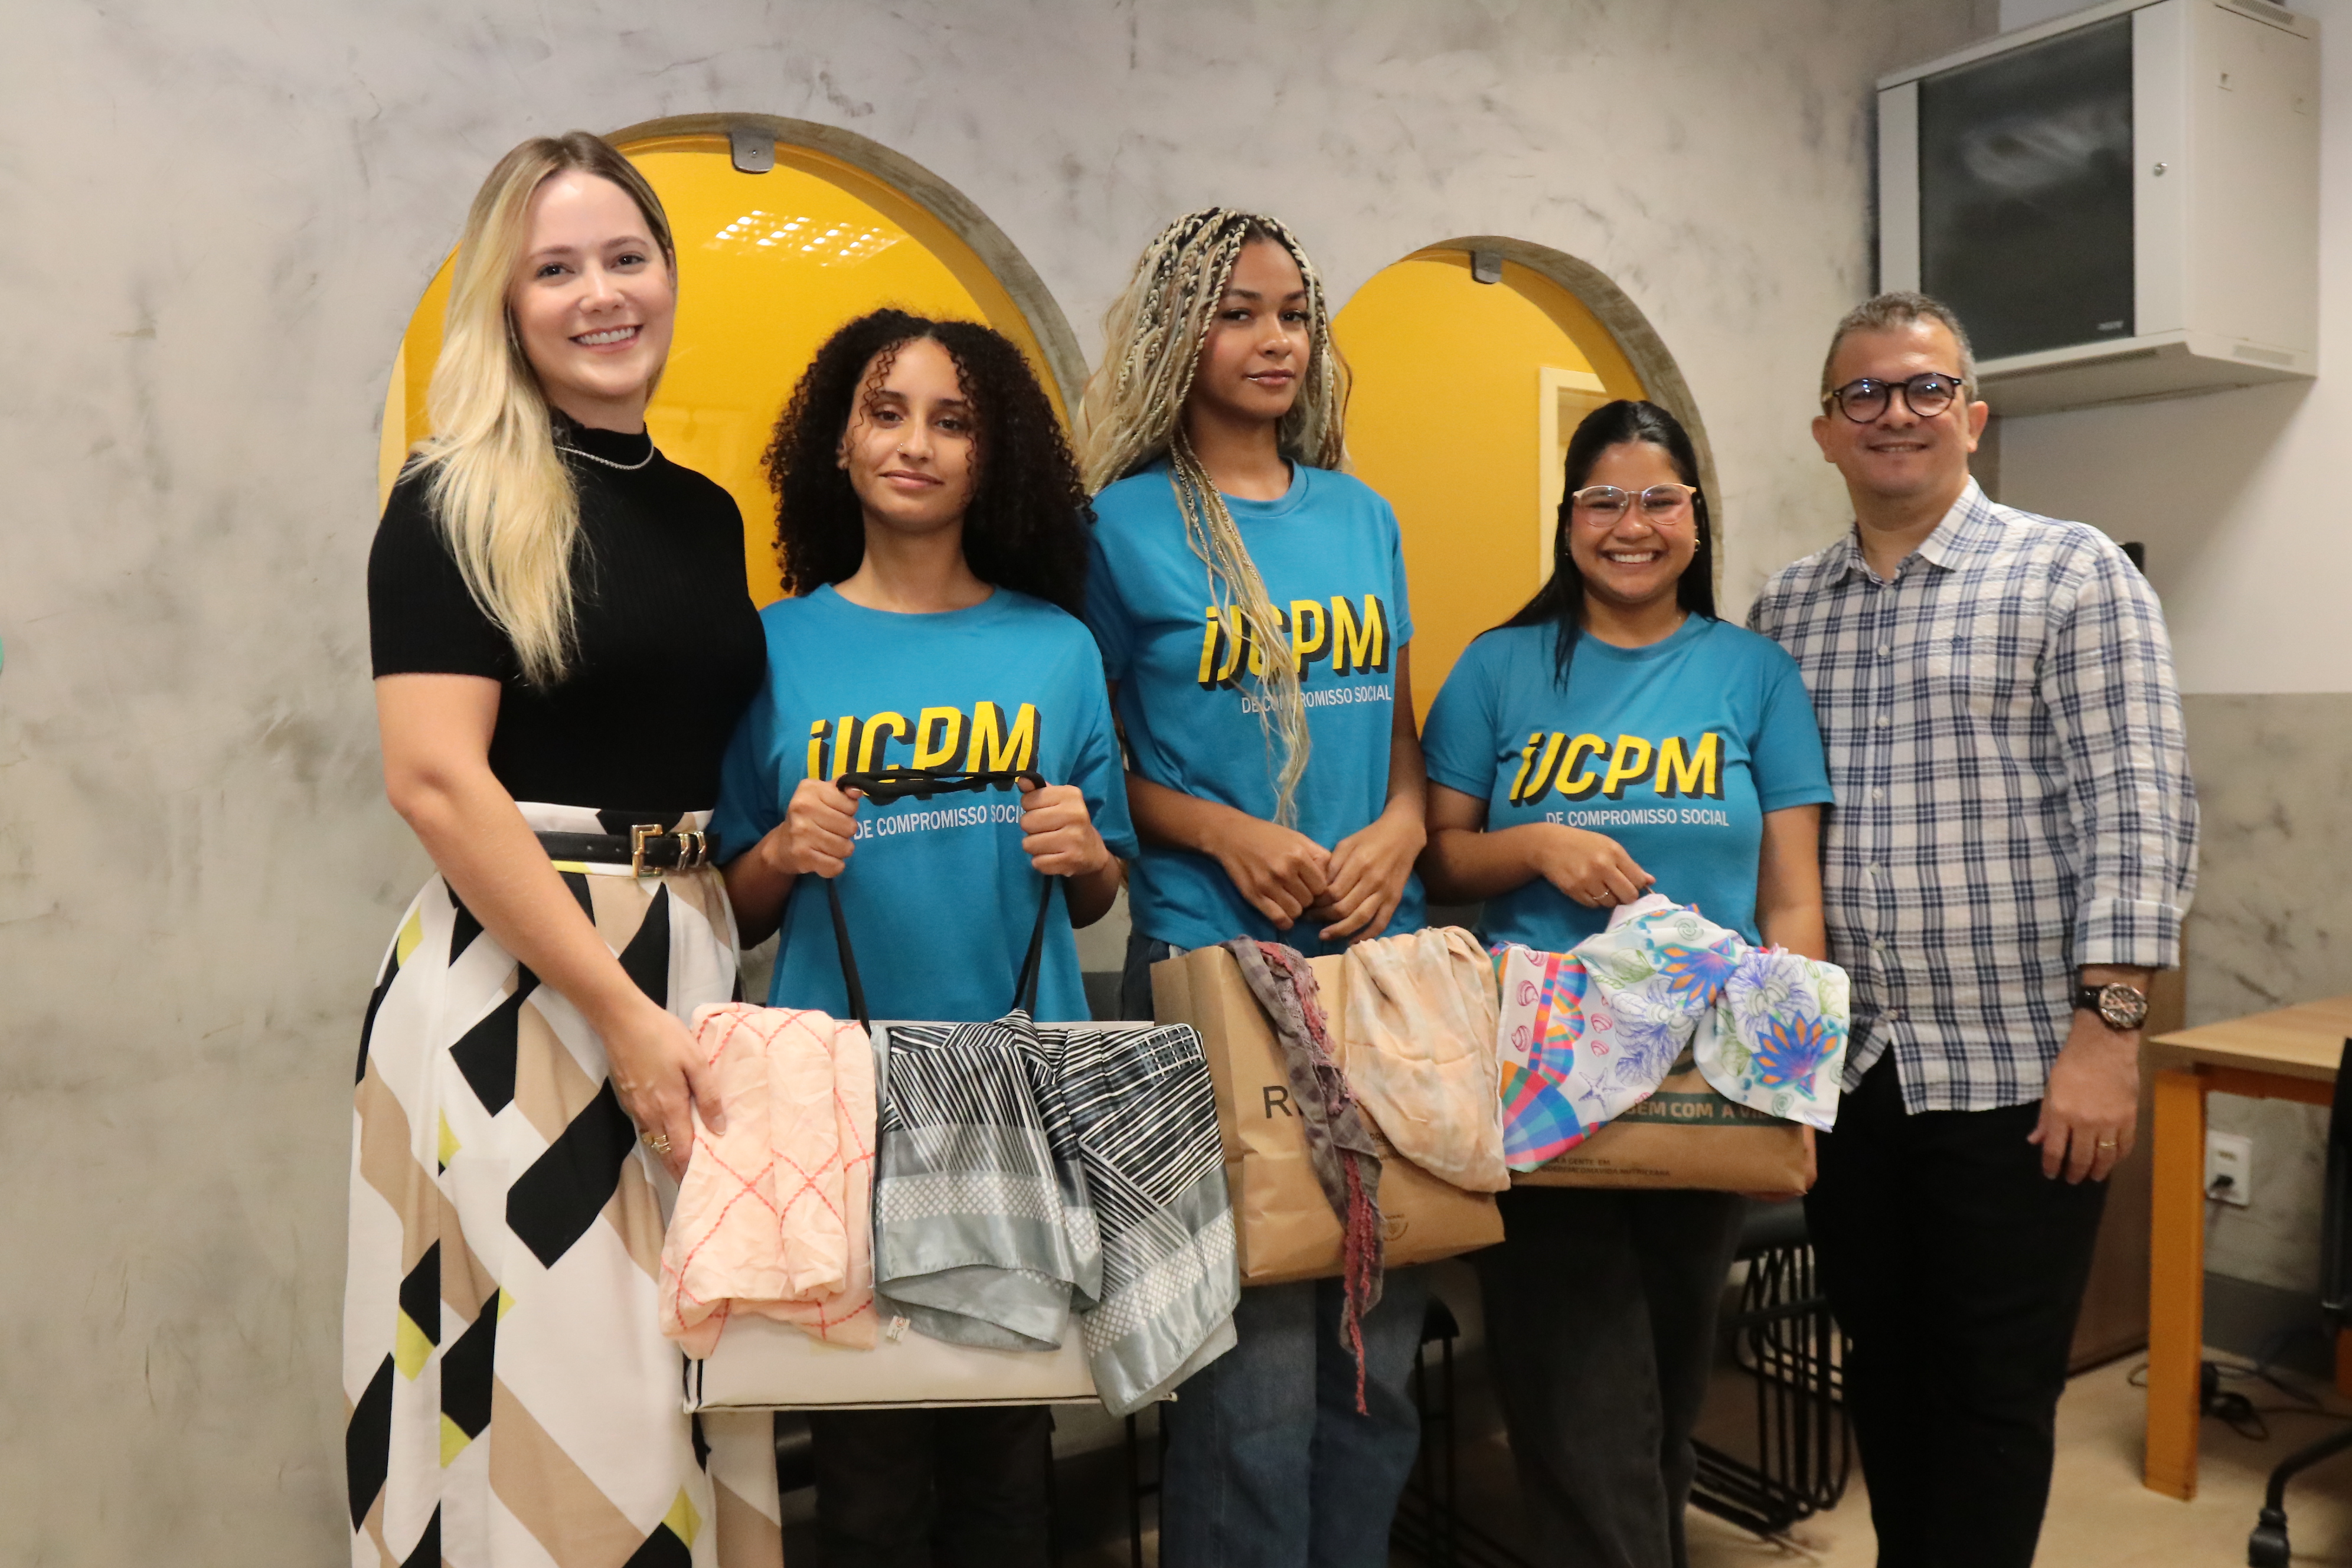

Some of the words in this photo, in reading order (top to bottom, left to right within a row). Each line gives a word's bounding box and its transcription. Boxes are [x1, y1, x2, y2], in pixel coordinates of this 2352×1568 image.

[1263, 688, 1353, 712] CROMISSO
[1354, 684, 1391, 703] SOCIAL
[854, 819, 874, 840] DE
[876, 805, 987, 837] COMPROMISSO
[991, 804, 1026, 824] SOCI
[1546, 812, 1564, 824] DE
[1567, 808, 1677, 827] COMPROMISSO
[1681, 808, 1730, 827] SOCIAL
[1670, 1102, 1713, 1119] COM
[1721, 1104, 1736, 1119] A
